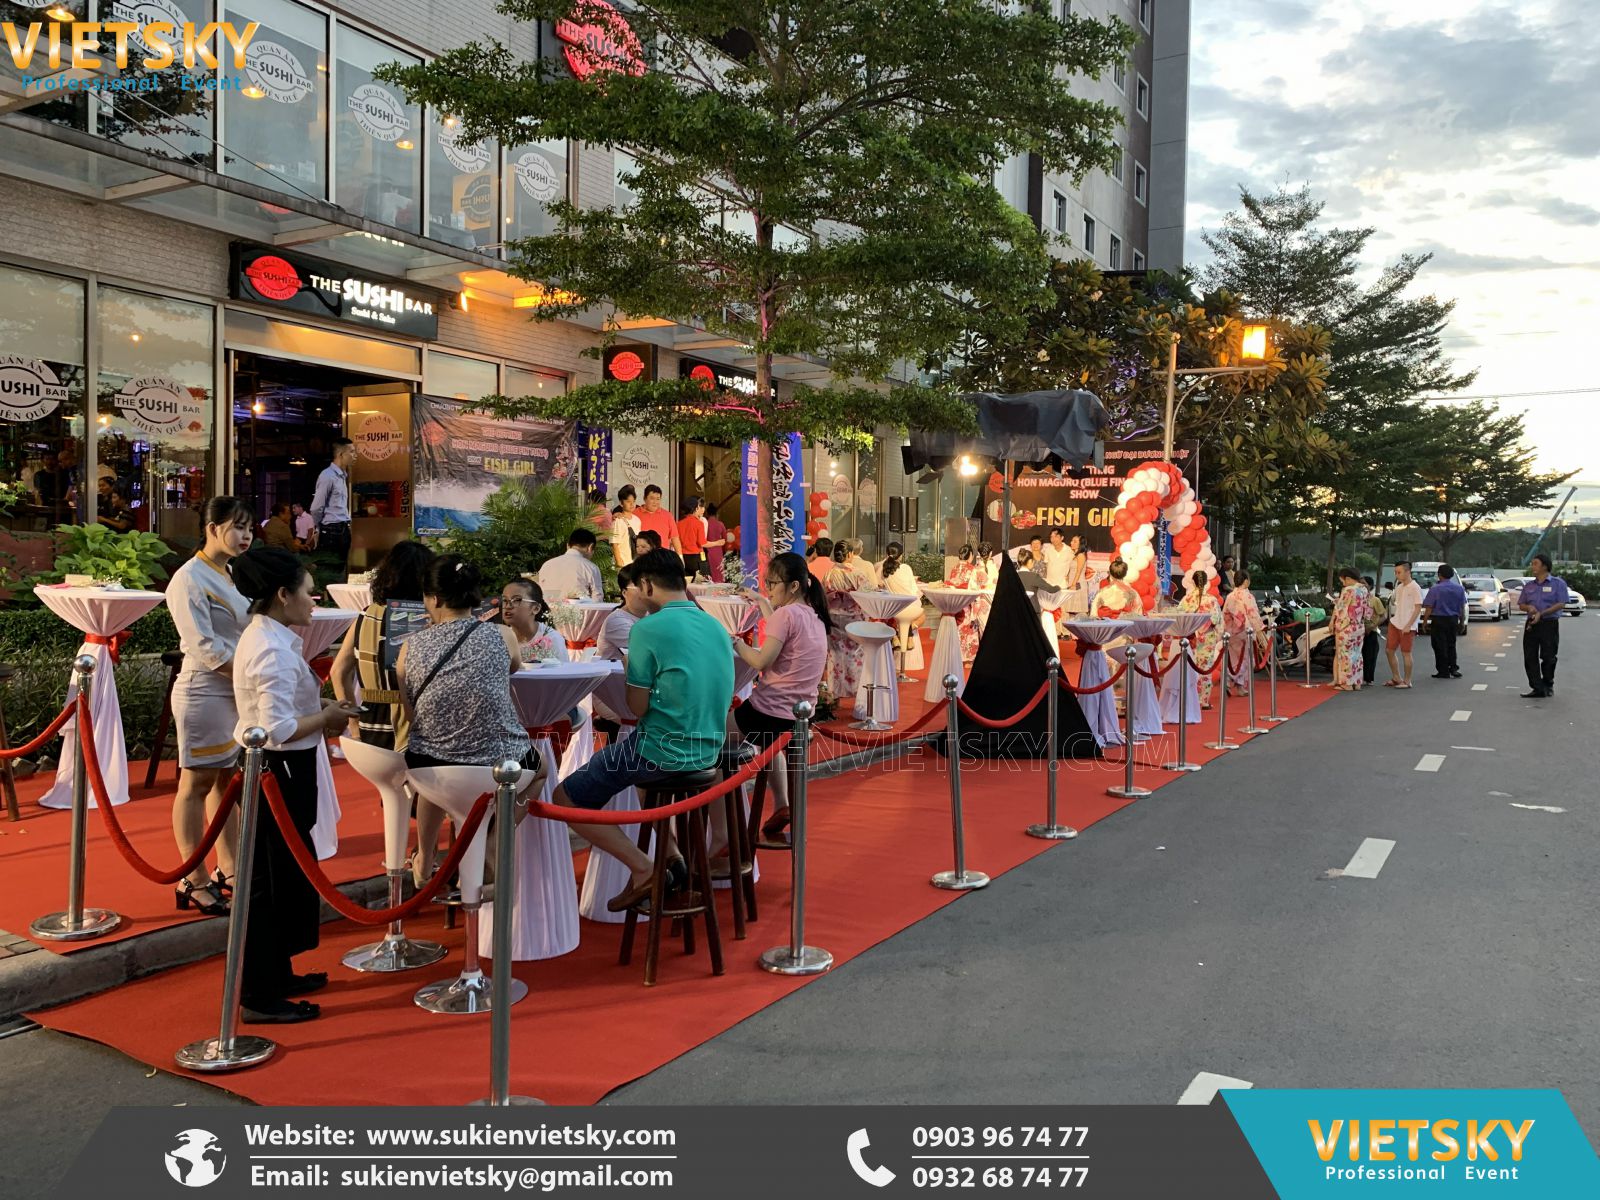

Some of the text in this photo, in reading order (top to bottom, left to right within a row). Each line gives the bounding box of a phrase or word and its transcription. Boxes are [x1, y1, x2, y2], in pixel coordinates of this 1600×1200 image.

[113, 5, 134, 19] THE
[246, 58, 312, 90] HE SUSHI BAR
[350, 100, 409, 127] THE SUSHI BAR
[527, 169, 548, 184] SUSHI
[309, 274, 433, 315] THE SUSHI BAR
[371, 312, 379, 321] &
[136, 376, 165, 388] QUÁN
[718, 375, 733, 387] THE
[0, 380, 67, 398] USHI BAR
[116, 396, 200, 414] THE SUSHI BAR
[367, 432, 389, 442] SUSHI
[484, 456, 537, 475] FISH GIRL
[632, 460, 649, 470] SUSHI
[1017, 478, 1038, 487] HON
[1039, 478, 1078, 487] MAGURO
[1070, 489, 1100, 499] SHOW
[1036, 507, 1080, 526] FISH
